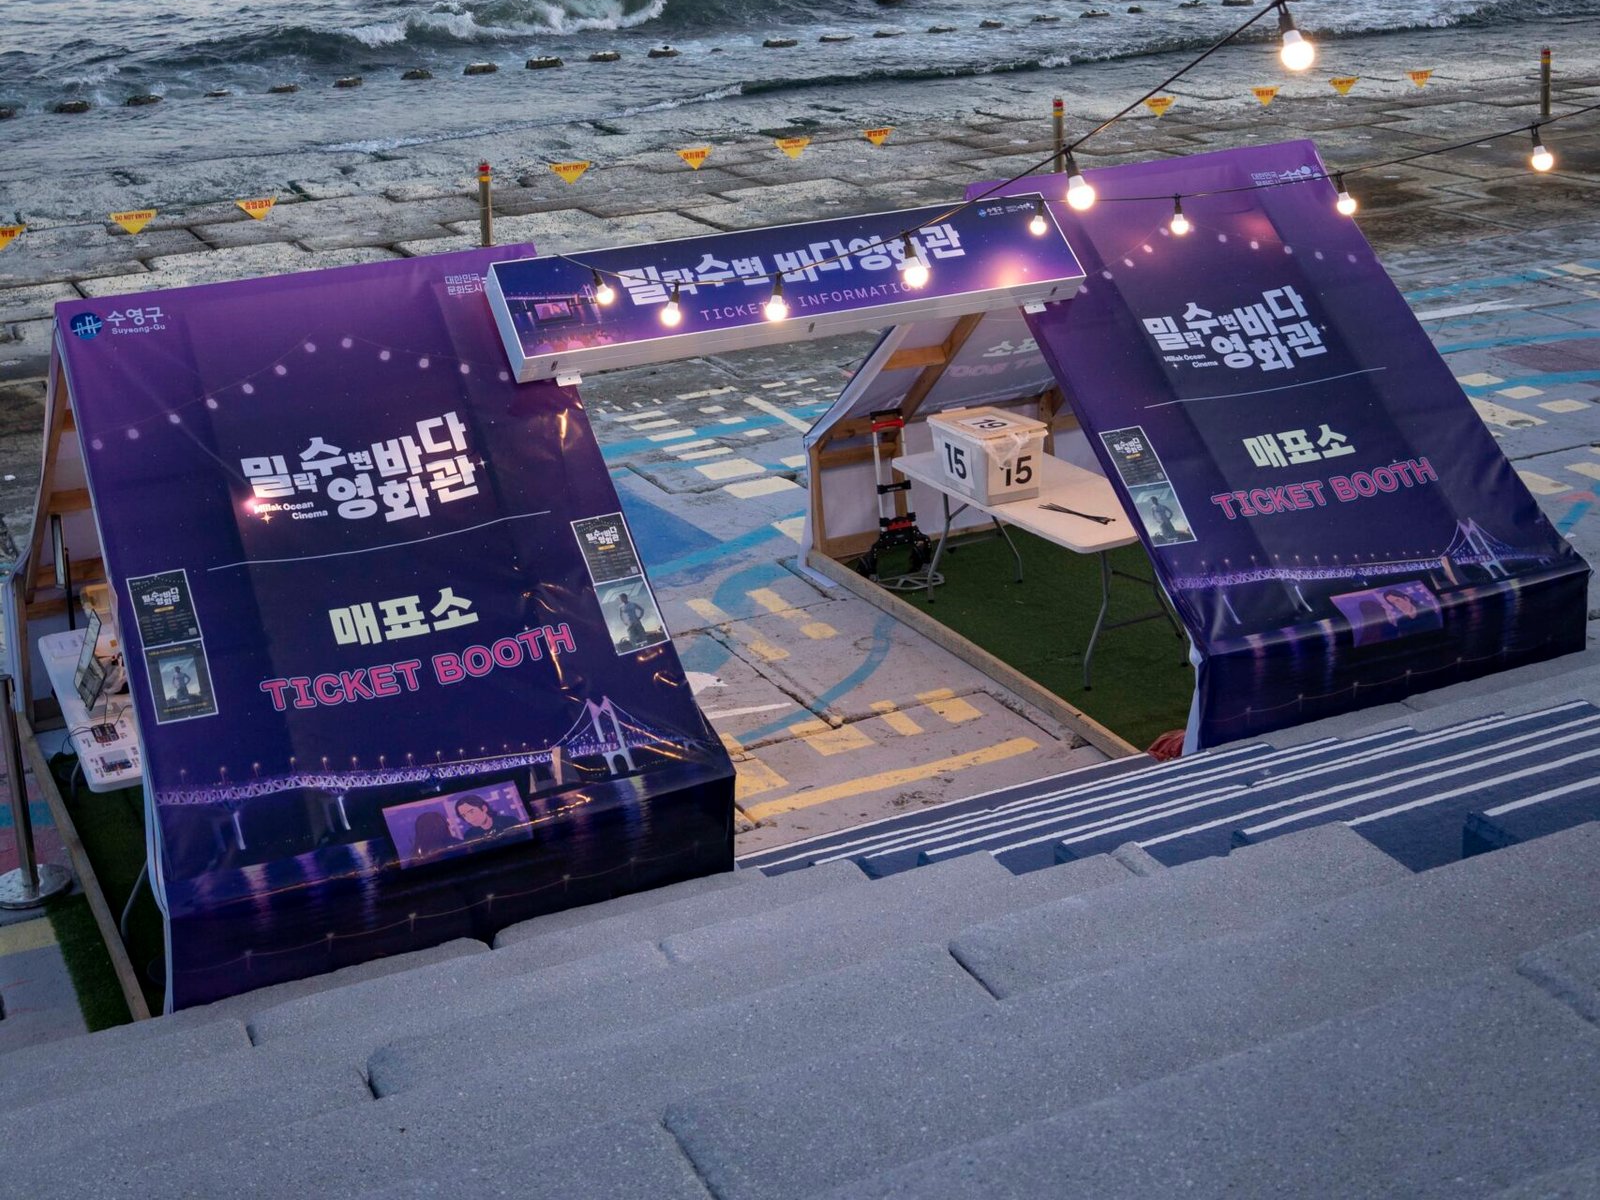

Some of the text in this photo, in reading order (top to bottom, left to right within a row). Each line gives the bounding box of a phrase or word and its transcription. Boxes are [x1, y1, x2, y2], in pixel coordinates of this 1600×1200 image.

[445, 273, 480, 284] 대한민국
[447, 283, 482, 296] 문화도시
[617, 253, 770, 306] 밀락수변
[700, 281, 924, 321] TICKET INFORMATIO
[106, 307, 164, 327] 수영구
[112, 324, 166, 335] Suyeong-Gu
[1184, 353, 1206, 361] Ocean
[1192, 360, 1219, 368] Cinema
[1242, 423, 1357, 468] 매표소
[944, 442, 967, 480] 15
[1000, 455, 1033, 486] 15
[1210, 456, 1439, 520] TICKET BOOTH
[282, 500, 314, 511] Ocean
[291, 509, 328, 520] Cinema
[328, 587, 479, 645] 매표소
[259, 622, 577, 711] TICKET BOOTH
